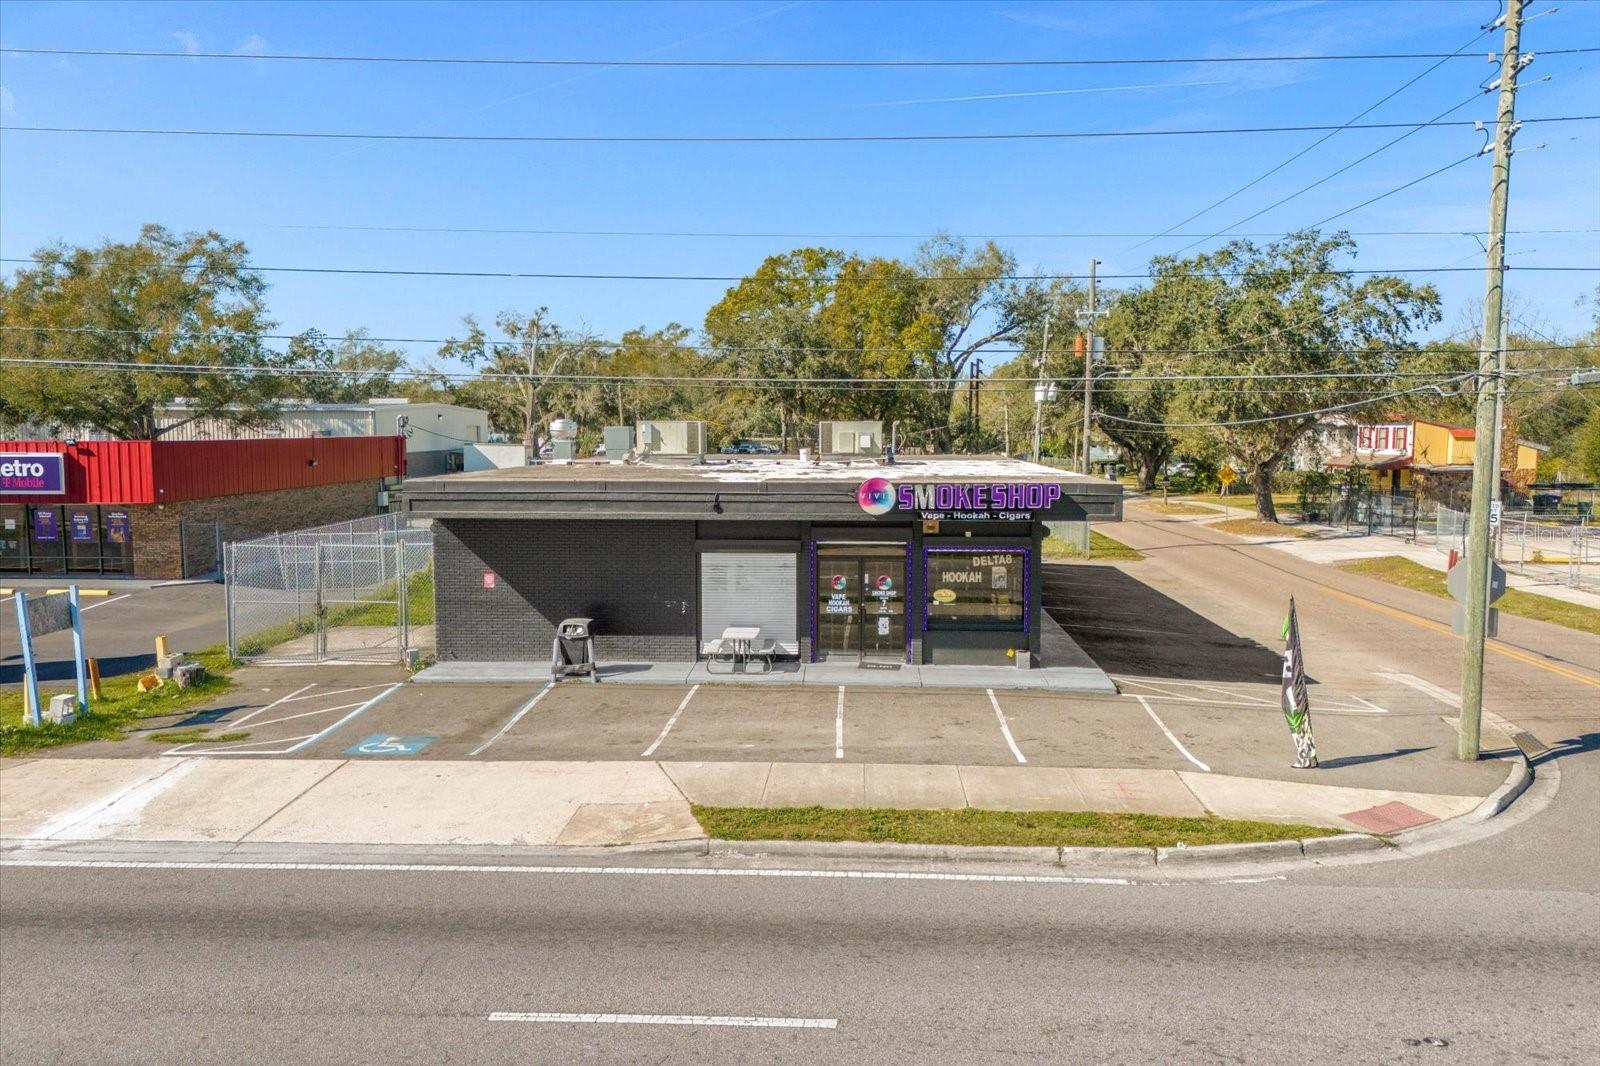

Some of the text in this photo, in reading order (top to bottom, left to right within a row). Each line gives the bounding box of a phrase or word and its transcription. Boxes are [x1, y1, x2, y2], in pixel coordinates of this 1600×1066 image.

[0, 459, 44, 477] etro
[13, 478, 45, 488] Mobile
[898, 483, 1061, 510] SMOKE SHOP
[921, 511, 945, 520] Vape
[953, 511, 990, 519] Hookah
[998, 511, 1031, 521] Cigars
[1490, 513, 1498, 523] 5
[942, 571, 982, 583] HOOKAH
